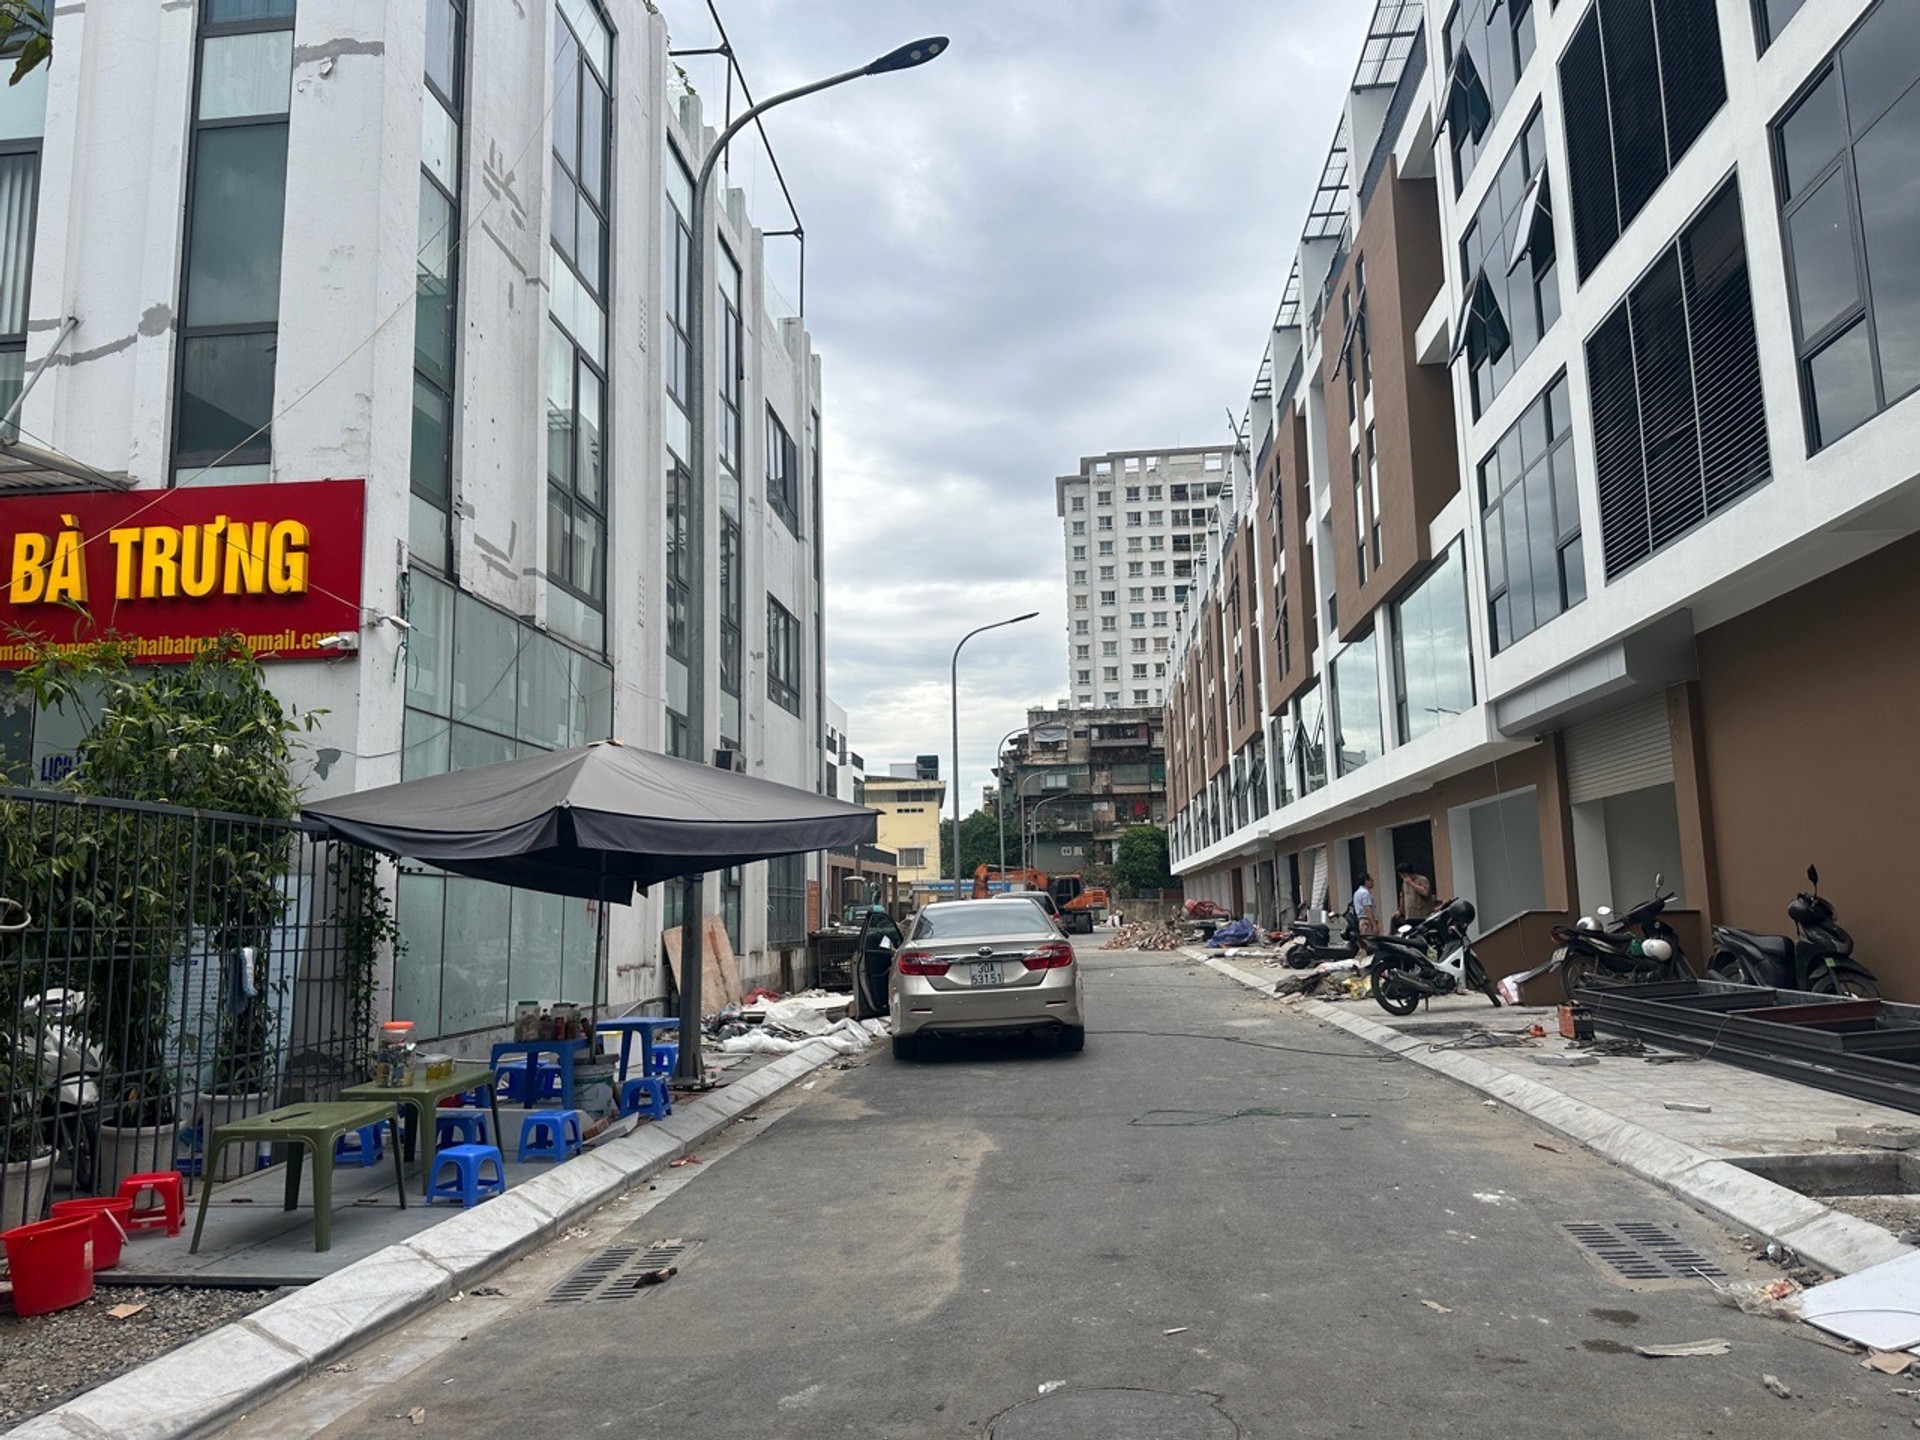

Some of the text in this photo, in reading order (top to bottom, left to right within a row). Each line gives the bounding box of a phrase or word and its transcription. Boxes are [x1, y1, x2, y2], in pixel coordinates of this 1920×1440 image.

[9, 514, 311, 604] BÀ TRƯNG
[978, 962, 996, 973] 30A
